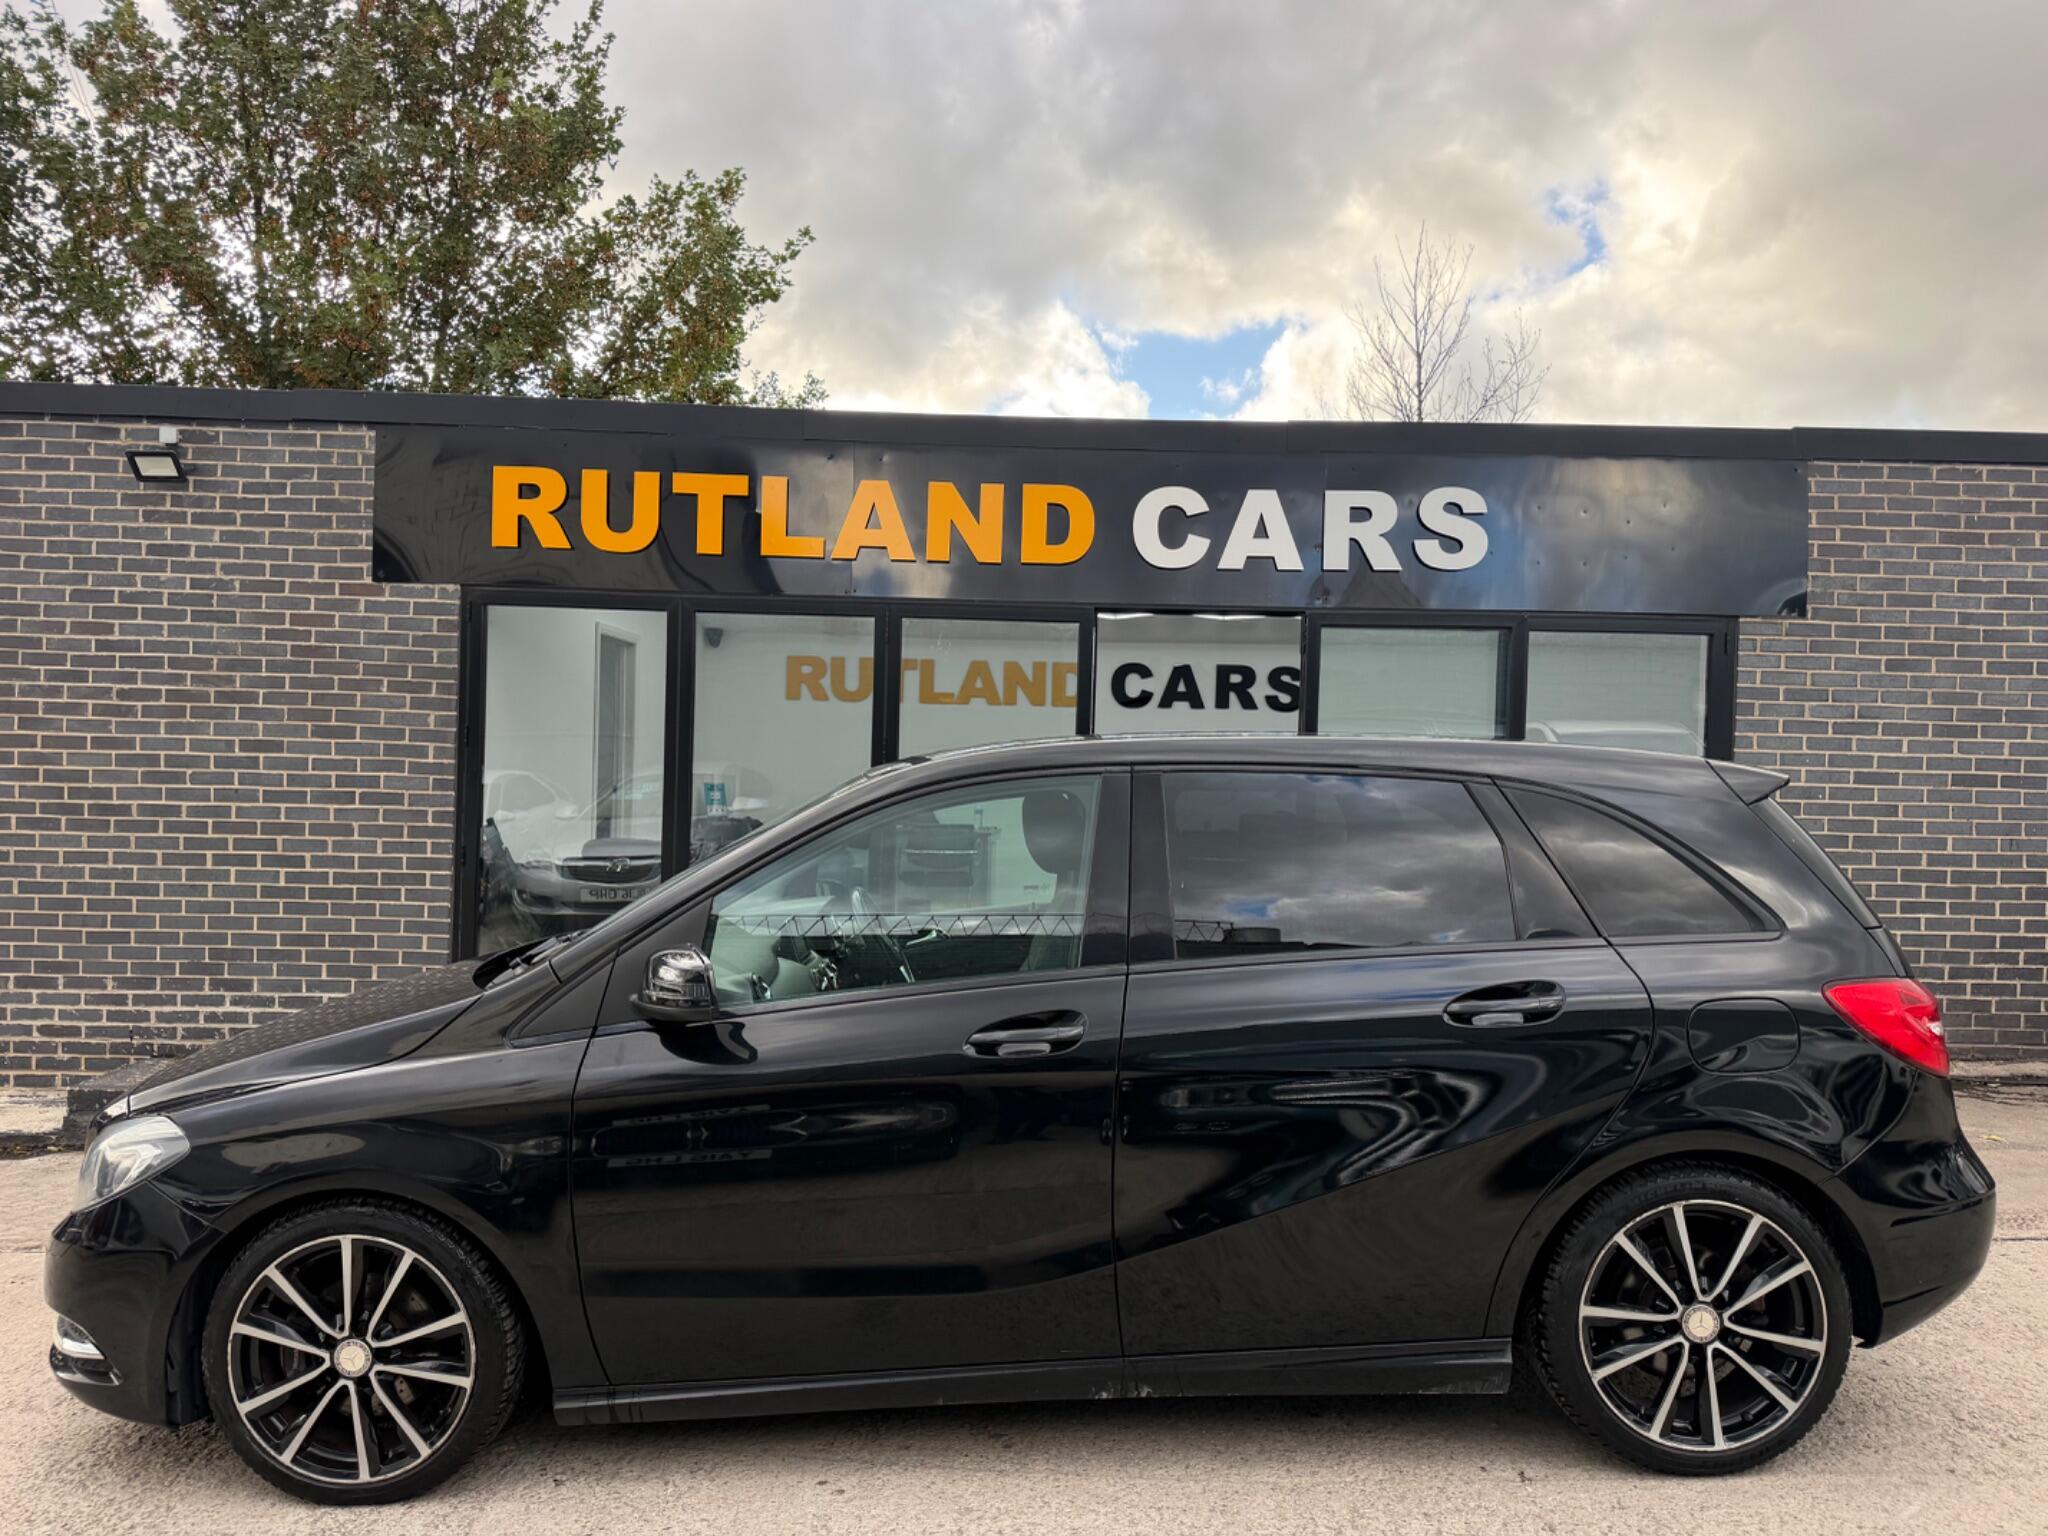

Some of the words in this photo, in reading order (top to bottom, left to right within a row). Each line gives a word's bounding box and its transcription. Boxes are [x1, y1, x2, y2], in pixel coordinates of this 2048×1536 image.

[490, 465, 1096, 565] RUTLAND
[1131, 485, 1489, 572] CARS
[1111, 663, 1300, 713] CARS
